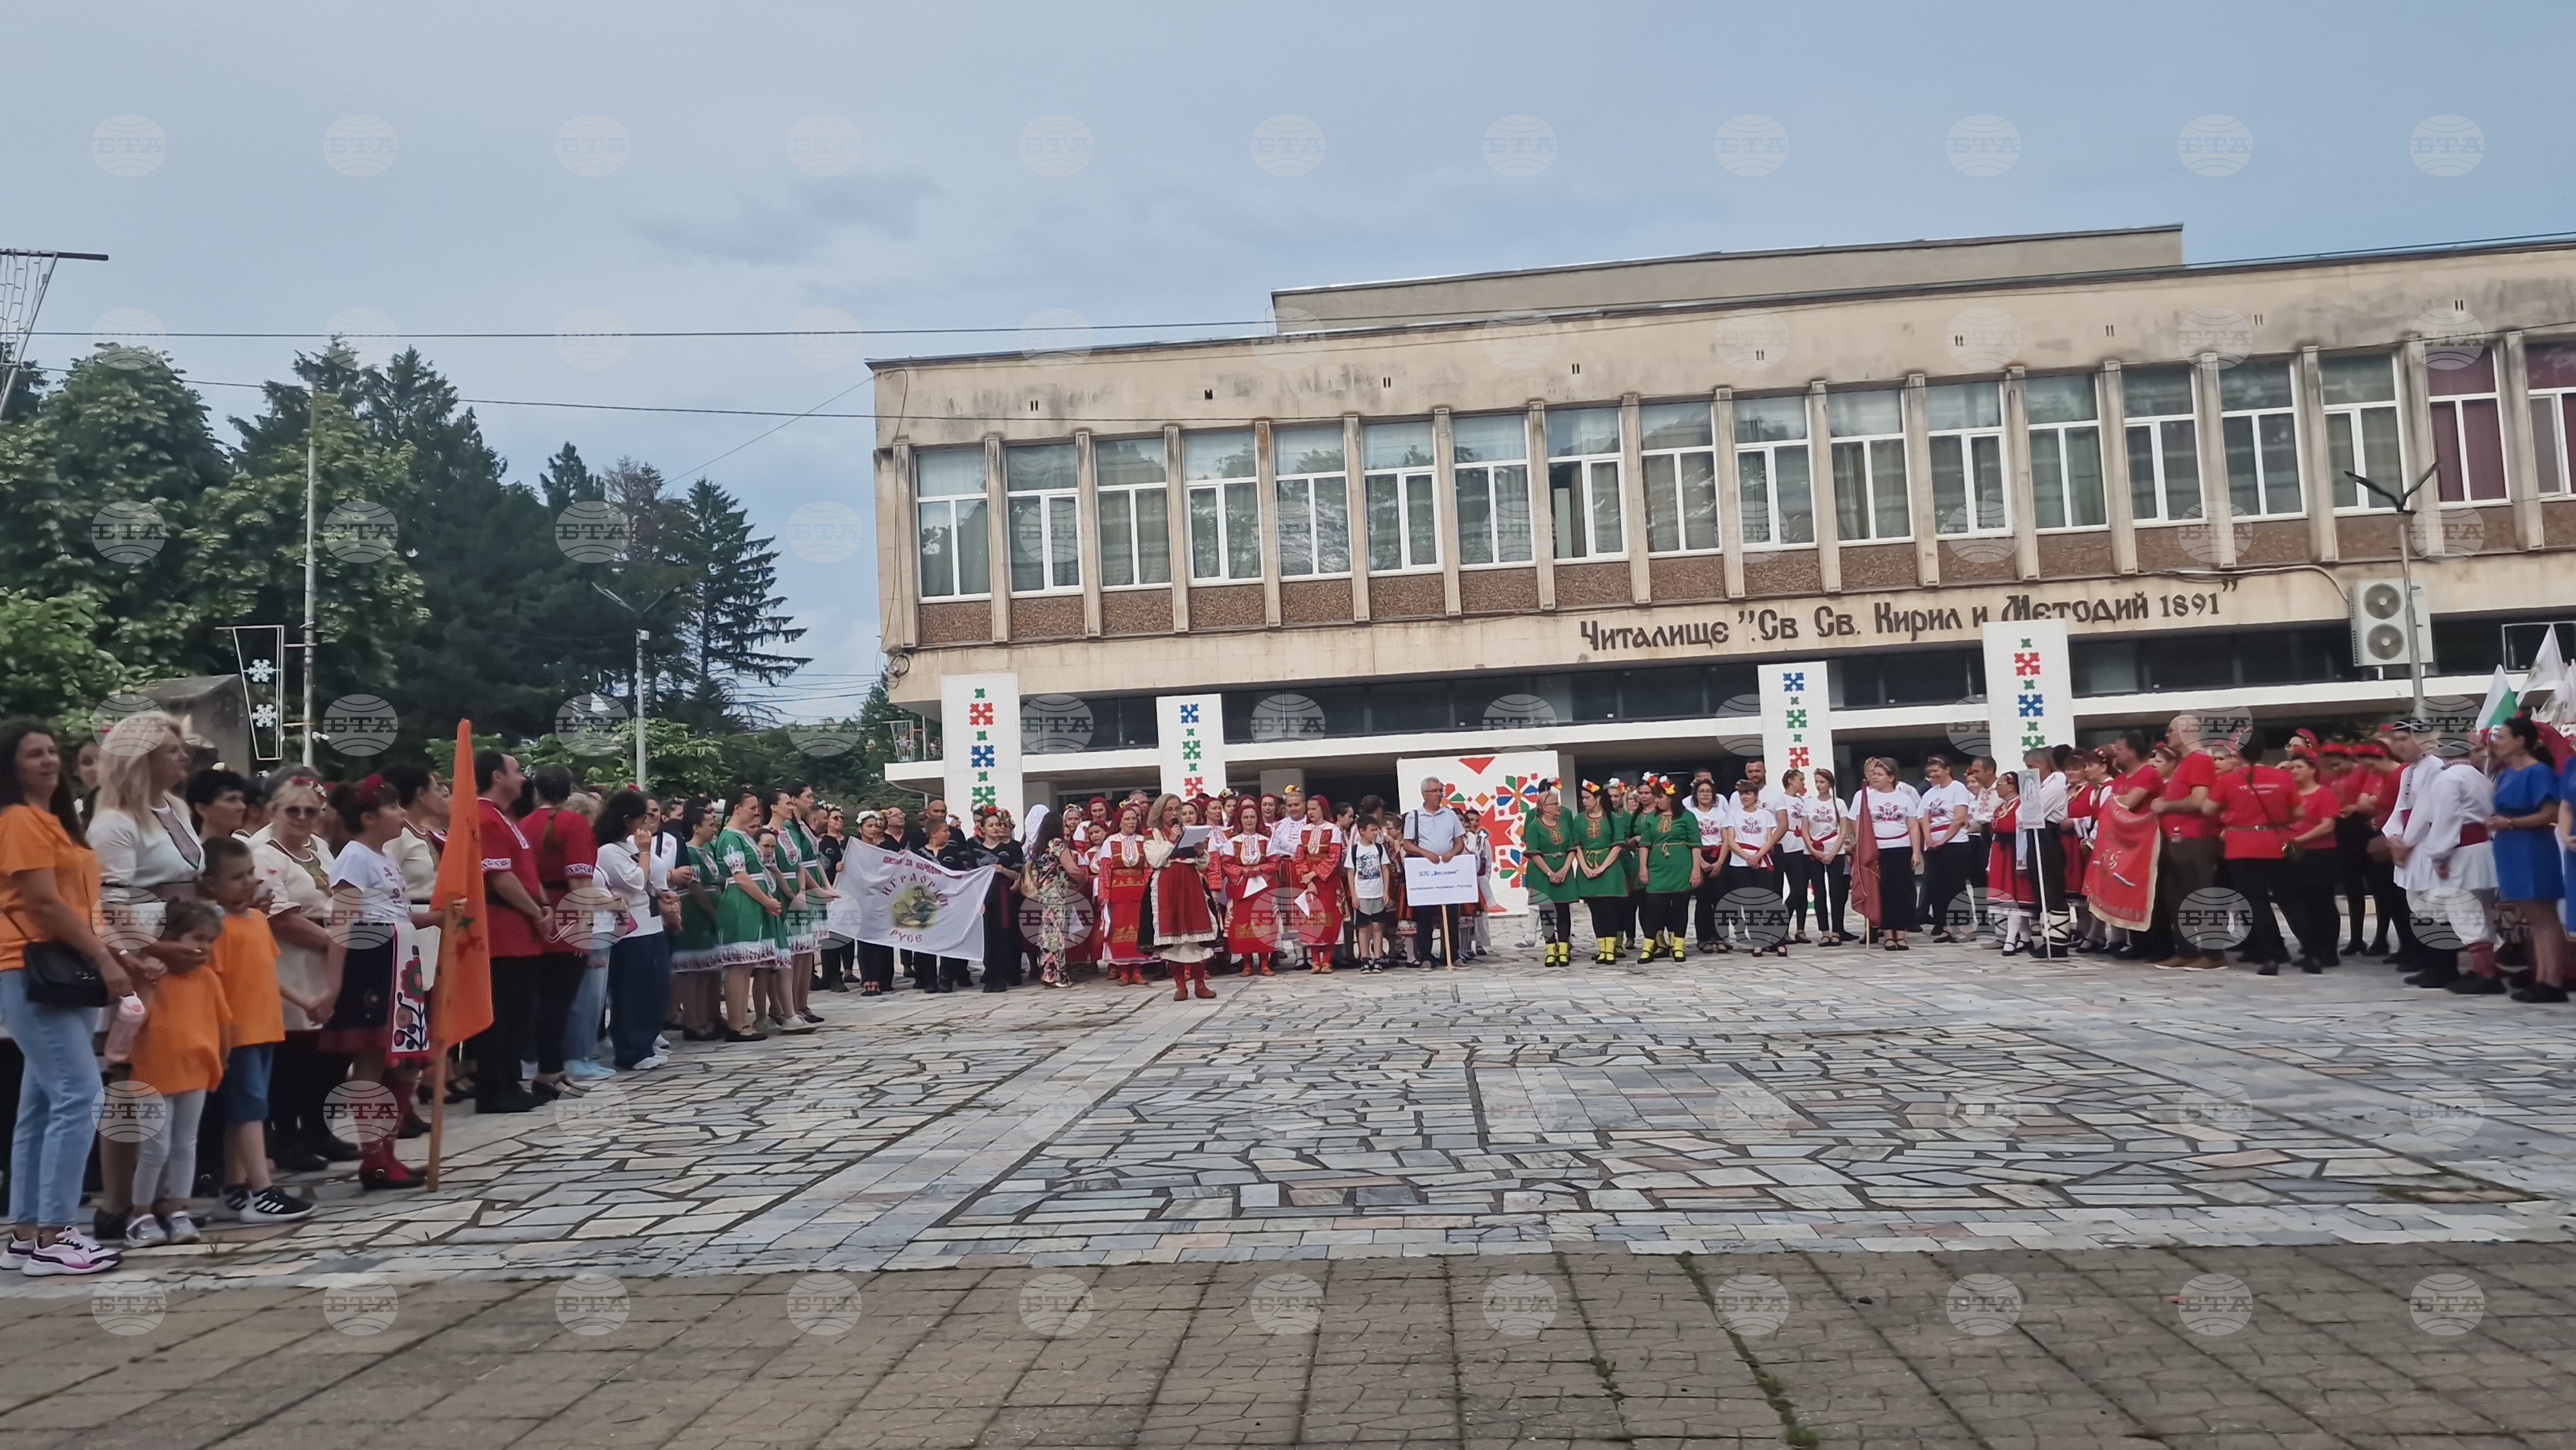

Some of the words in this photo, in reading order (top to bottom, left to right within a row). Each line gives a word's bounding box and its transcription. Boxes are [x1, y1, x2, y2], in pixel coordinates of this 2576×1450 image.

[1580, 620, 1730, 650] Читалище
[1814, 605, 1861, 637] Св.
[1874, 602, 1963, 641] Кирил
[1973, 606, 1988, 628] и
[2001, 592, 2149, 624] Методий
[890, 929, 923, 943] РУСЕ
